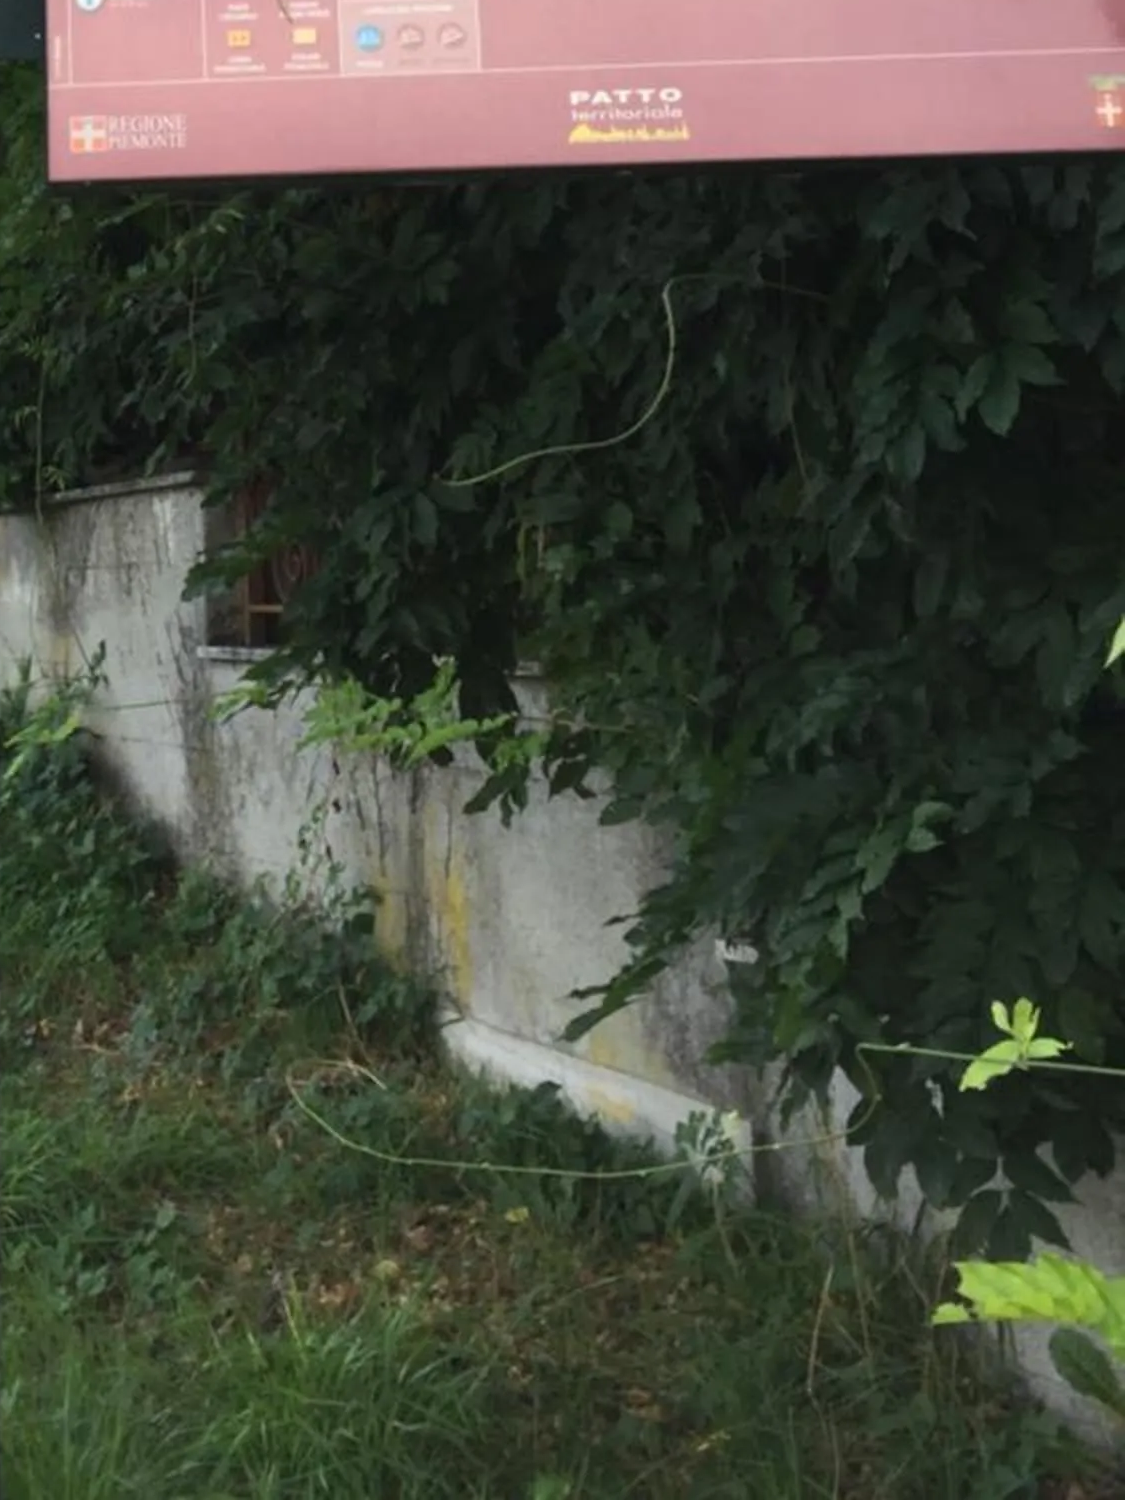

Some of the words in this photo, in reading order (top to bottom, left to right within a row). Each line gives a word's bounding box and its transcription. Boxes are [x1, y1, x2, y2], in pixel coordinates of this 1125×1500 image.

[569, 88, 682, 105] PATTO
[108, 113, 187, 133] REGIONE
[109, 133, 187, 150] PIEMONTE
